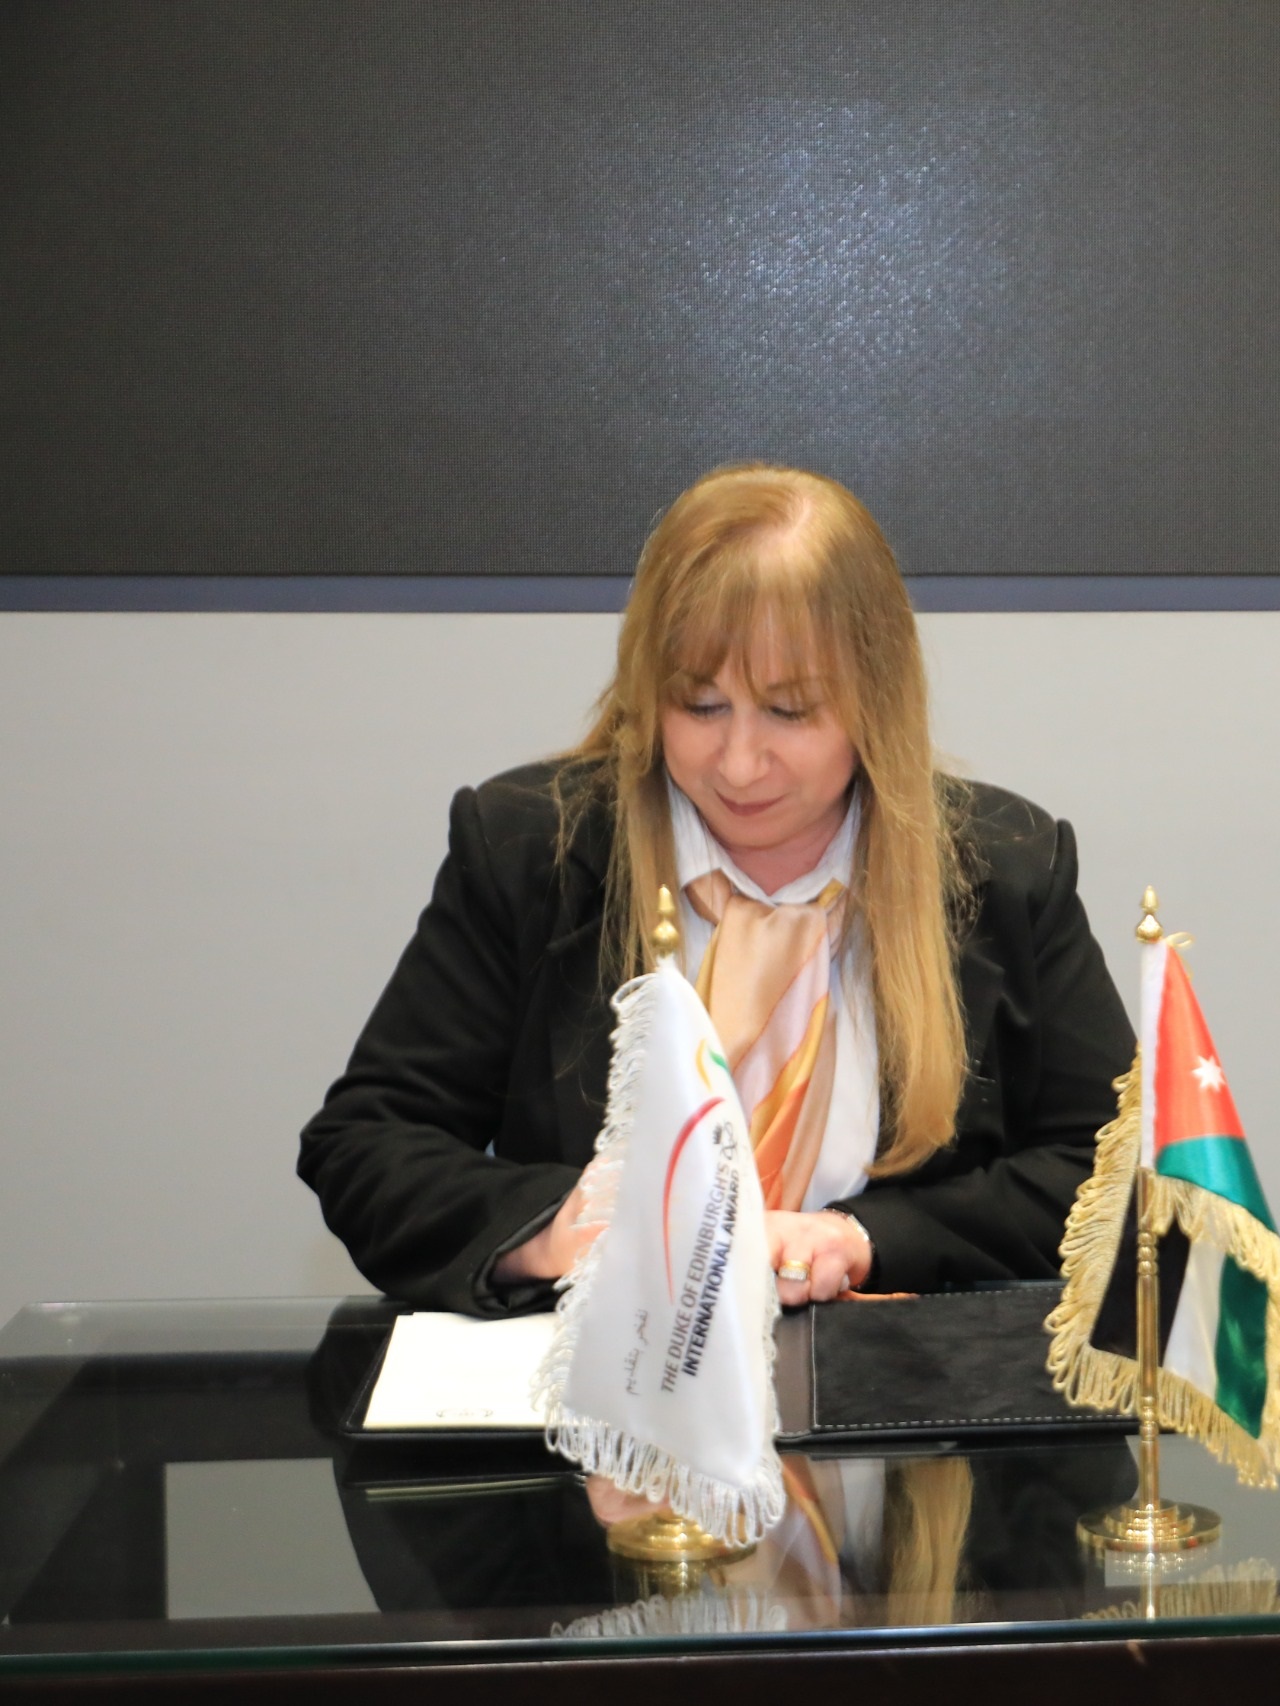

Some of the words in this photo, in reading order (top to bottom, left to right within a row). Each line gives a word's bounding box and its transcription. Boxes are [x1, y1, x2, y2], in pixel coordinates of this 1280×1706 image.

[687, 1162, 729, 1283] EDINBURGH'S
[680, 1283, 699, 1309] OF
[681, 1241, 733, 1377] INTERNATIONAL
[721, 1169, 740, 1236] AWARD
[667, 1309, 693, 1360] DUKE
[660, 1359, 679, 1393] THE
